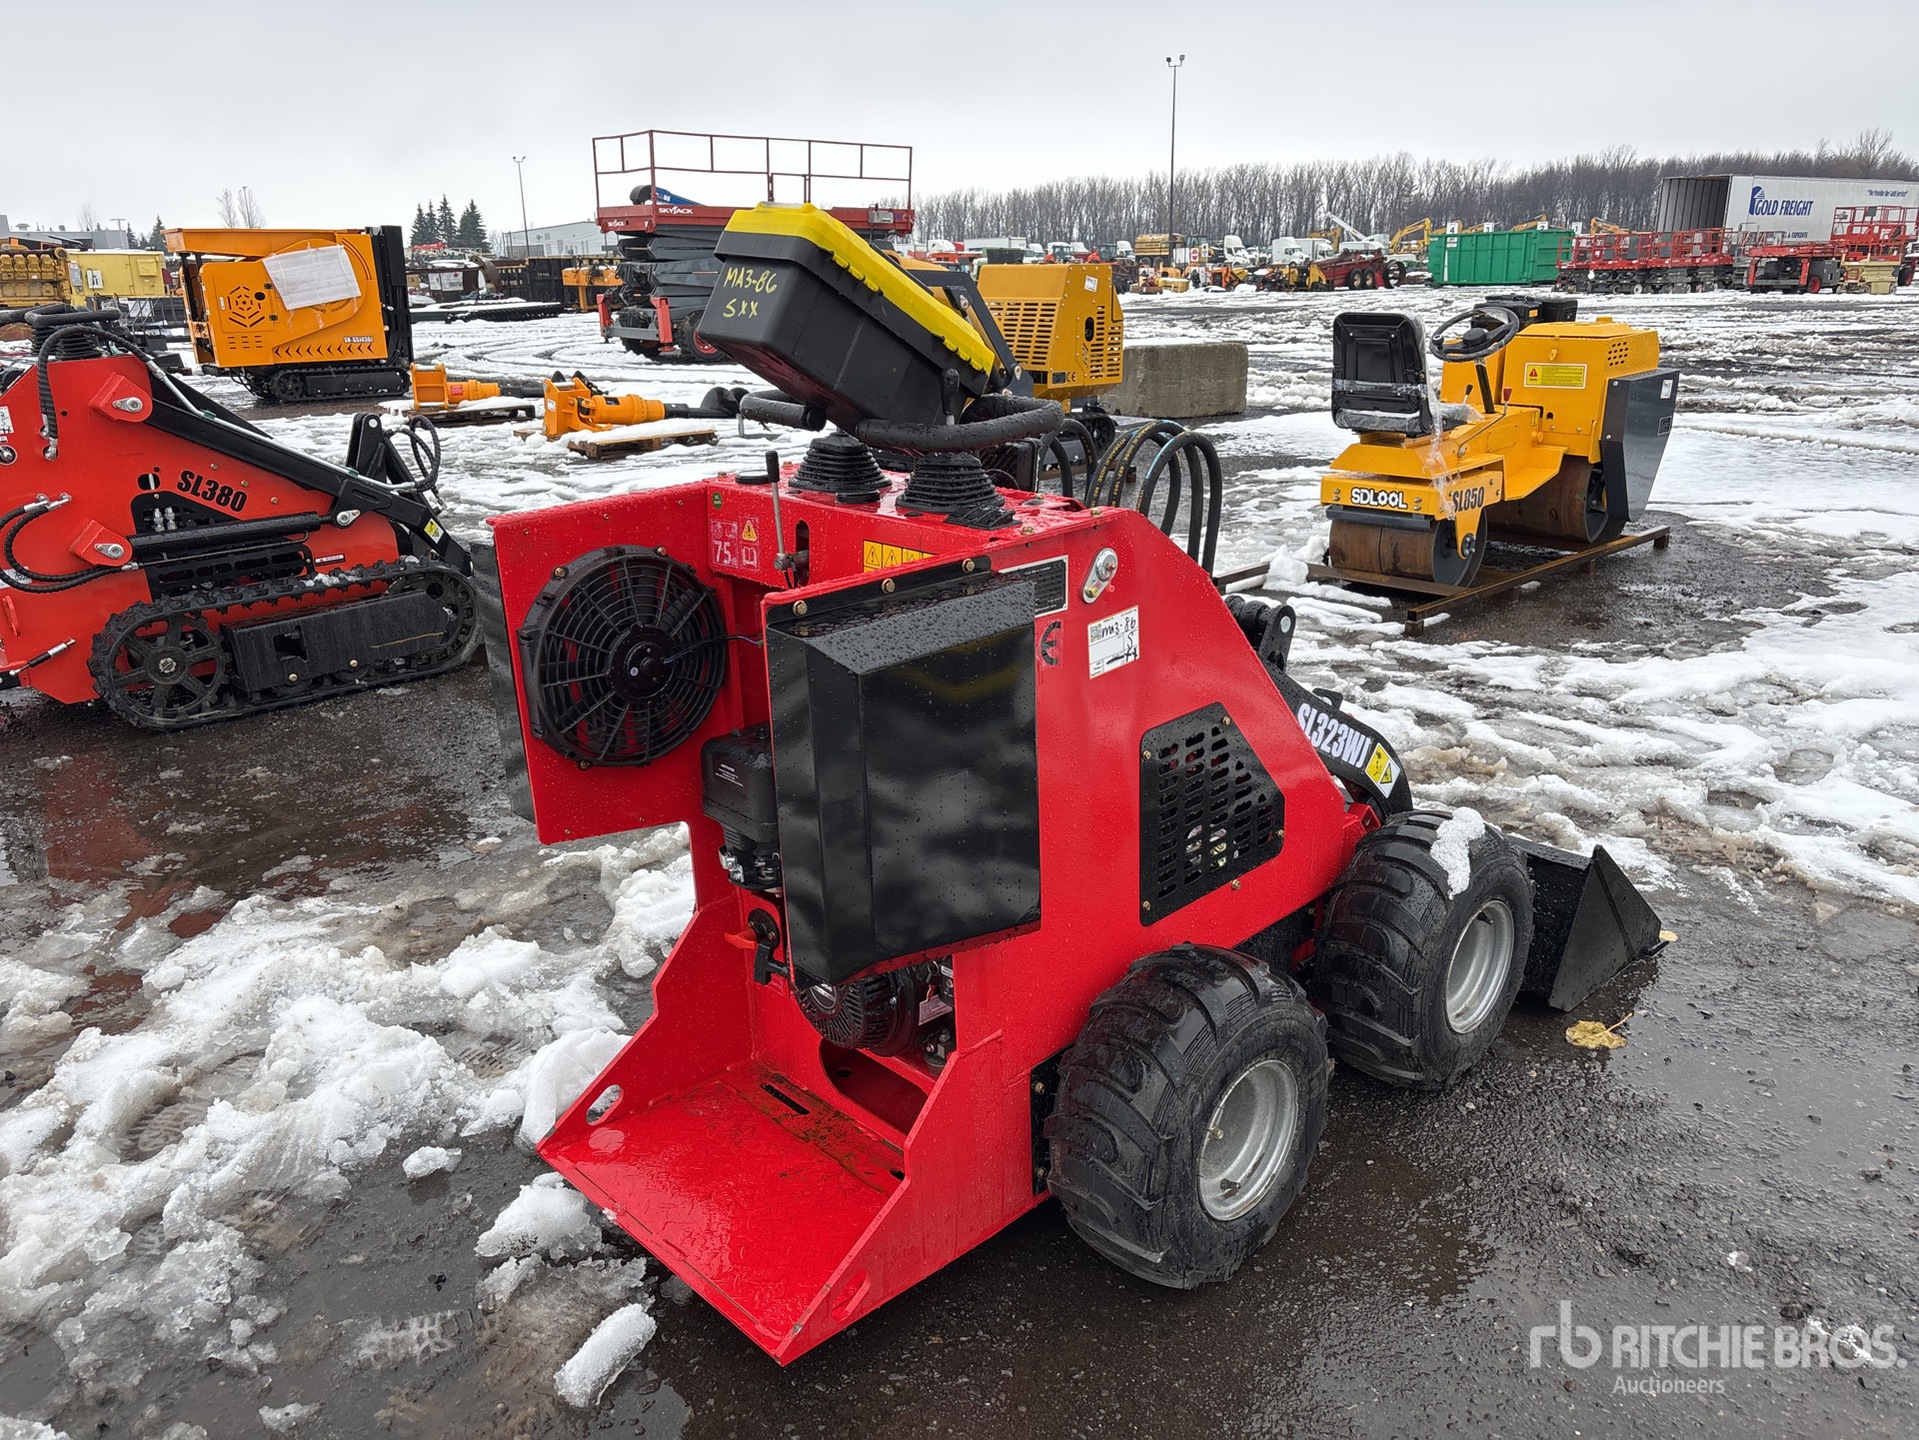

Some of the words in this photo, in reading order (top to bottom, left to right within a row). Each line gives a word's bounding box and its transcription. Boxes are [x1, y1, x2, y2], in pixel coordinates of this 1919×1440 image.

[658, 205, 693, 215] SKYJACK
[1755, 200, 1777, 216] GOLD
[1779, 200, 1814, 216] FREIGHT
[176, 470, 248, 513] SL380
[1351, 487, 1408, 509] SDLOOL
[1453, 486, 1485, 513] SL850
[714, 540, 732, 565] 75
